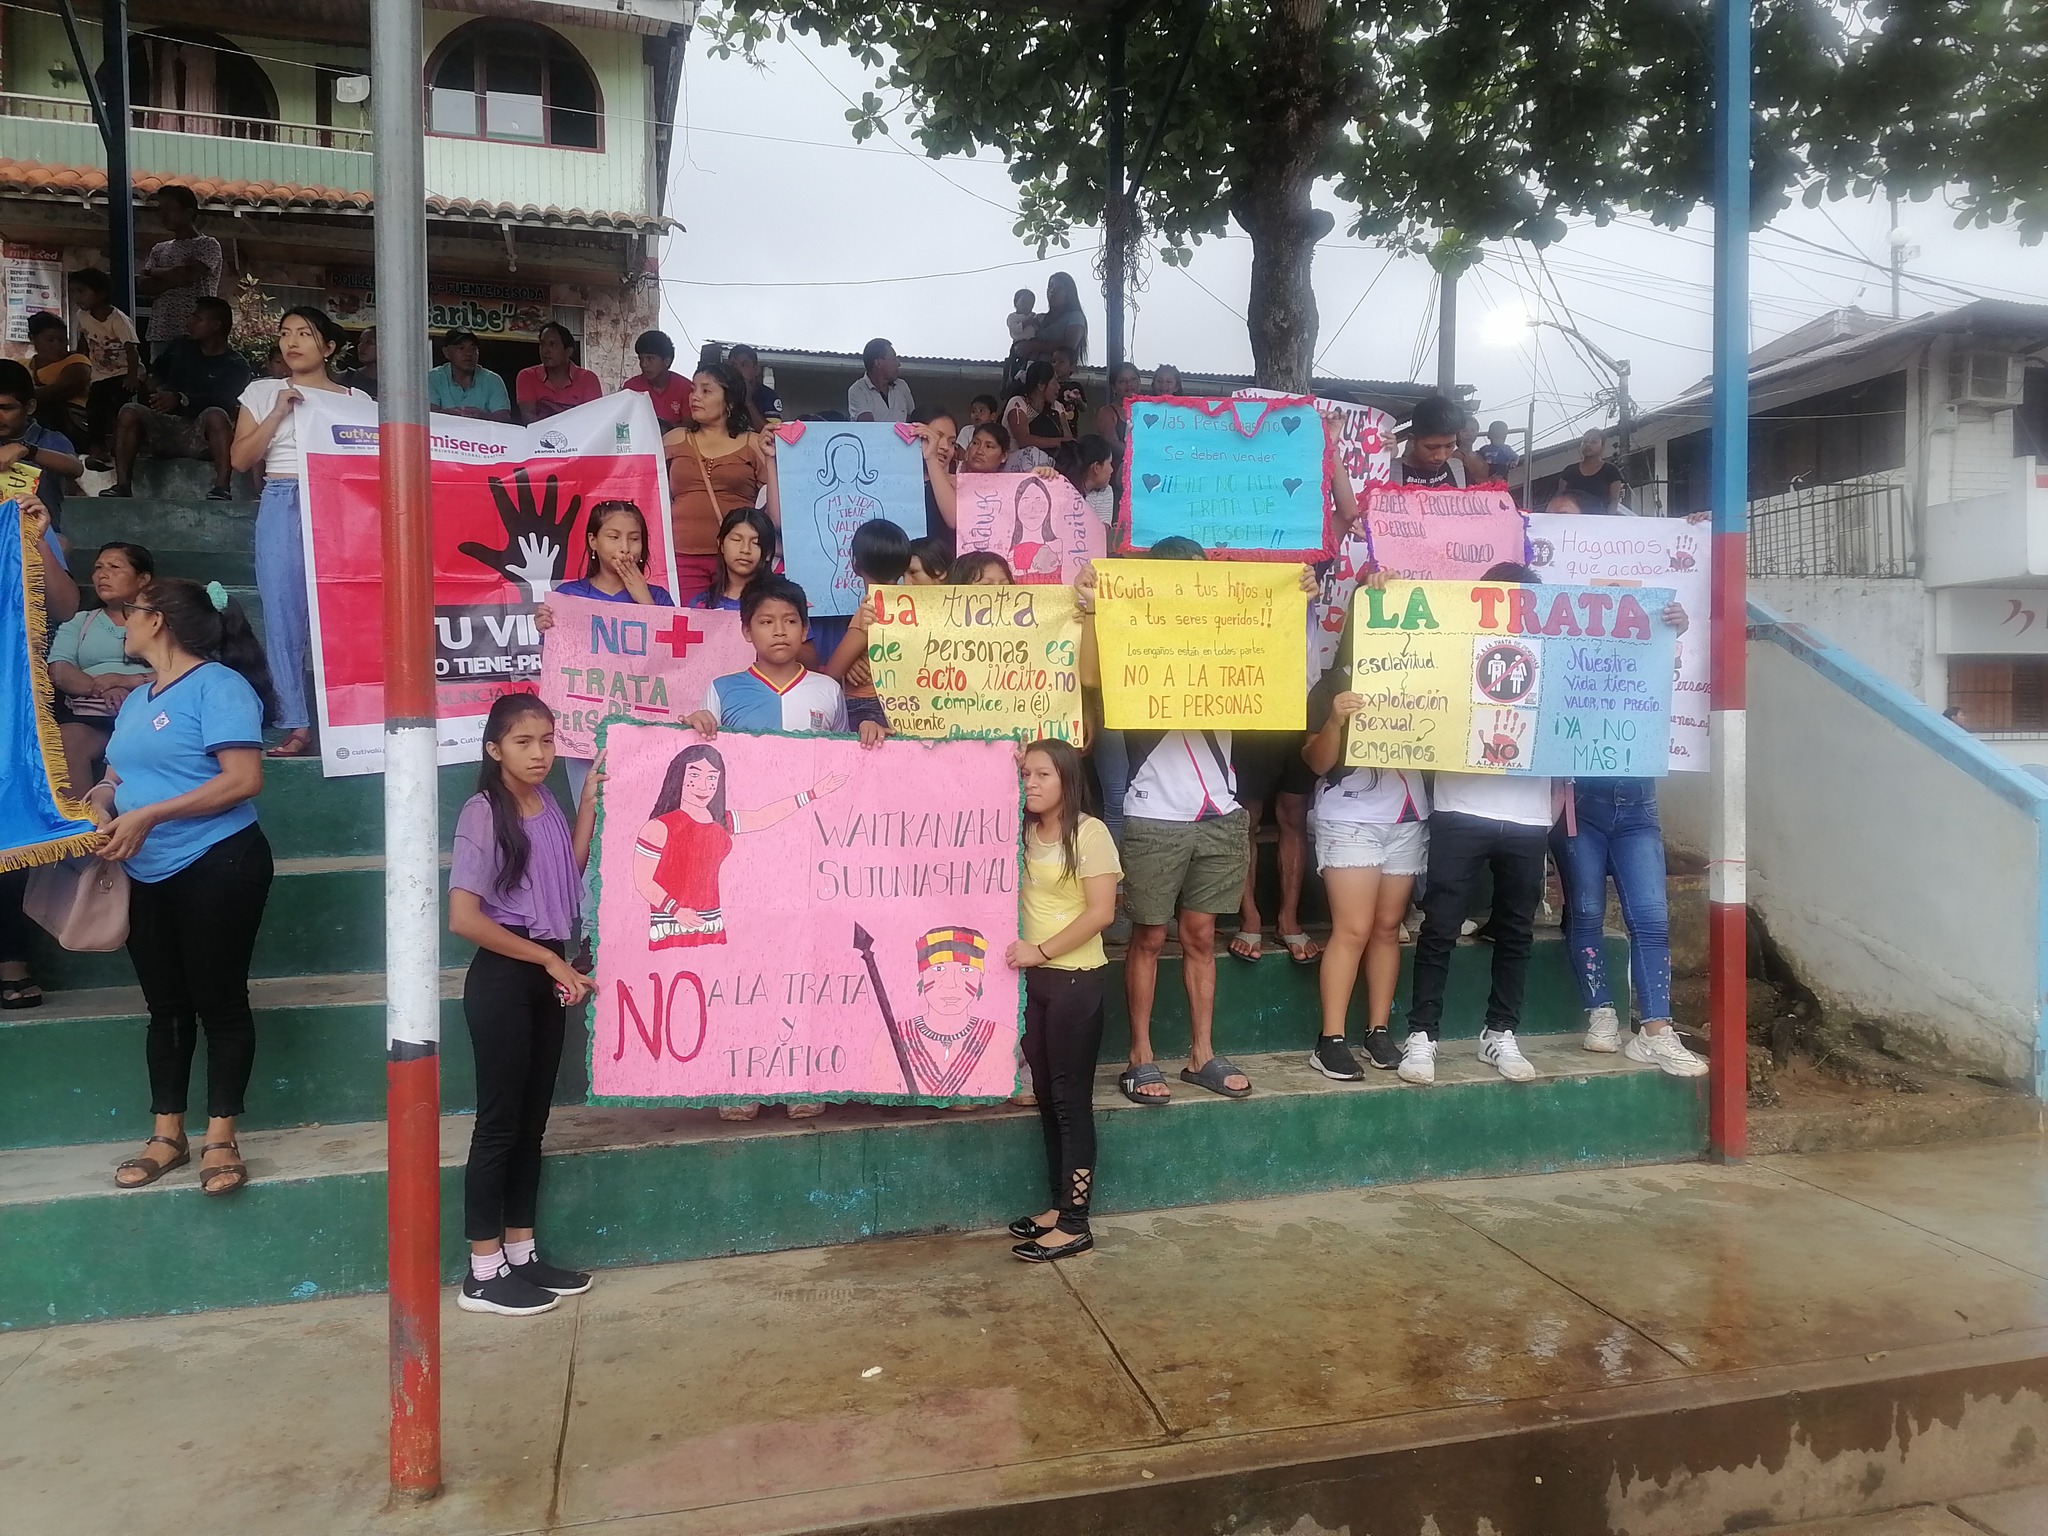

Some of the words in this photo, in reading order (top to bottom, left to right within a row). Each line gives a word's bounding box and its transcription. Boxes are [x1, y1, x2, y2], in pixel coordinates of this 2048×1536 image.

[331, 273, 376, 289] POLLER
[447, 282, 493, 298] FUENTE
[493, 284, 510, 298] DE
[510, 285, 545, 301] SODA
[338, 429, 379, 439] cutiva
[1260, 420, 1280, 433] no
[1164, 445, 1185, 461] Se
[1191, 447, 1228, 460] deben
[1233, 451, 1277, 463] vender
[1216, 474, 1238, 493] NO
[828, 495, 842, 511] MI
[847, 494, 875, 509] VIDA
[837, 507, 867, 518] TIENE
[1187, 497, 1242, 518] TRATA
[1253, 496, 1276, 516] DE
[1373, 492, 1409, 516] TENER
[1416, 490, 1492, 516] PROTECCIÓN
[1374, 519, 1427, 539] DERECHO
[1562, 530, 1662, 559] Hagamos
[1566, 560, 1600, 579] que
[1608, 562, 1664, 577] acabe
[834, 577, 865, 589] PREC
[1175, 584, 1184, 596] a
[1195, 571, 1218, 598] tus
[1228, 571, 1258, 604] hijos
[1265, 587, 1273, 607] y
[874, 589, 919, 627] La
[942, 586, 1039, 628] trata
[1365, 587, 1439, 630] LA
[1470, 587, 1652, 641] TRATA
[1129, 614, 1138, 627] a
[1145, 603, 1166, 625] tus
[1175, 613, 1208, 626] seres
[1214, 608, 1273, 635] queridos!!
[591, 614, 647, 656] NO
[868, 628, 903, 662] de
[923, 631, 1029, 667] personas
[1045, 639, 1075, 666] es
[1127, 643, 1142, 657] Los
[1143, 646, 1174, 659] engaños
[1177, 640, 1199, 657] están
[1239, 638, 1266, 659] partes
[1566, 645, 1637, 673] Nuestra
[435, 658, 450, 675] O
[453, 655, 514, 674] TIENE
[517, 654, 542, 671] PR
[1357, 651, 1439, 675] esclavitud.
[561, 667, 669, 707] TRATA
[874, 668, 897, 690] un
[916, 661, 967, 691] acto
[1055, 670, 1076, 693] no
[1123, 664, 1149, 688] NO
[1163, 664, 1175, 687] A
[1188, 663, 1209, 688] LA
[1219, 664, 1265, 687] TRATA
[1603, 673, 1647, 693] tiene
[608, 700, 631, 716] DE
[879, 694, 921, 712] seas
[931, 692, 1010, 715] cómplice,
[1013, 696, 1026, 714] la
[1149, 695, 1172, 719] DE
[1183, 693, 1263, 718] PERSONAS
[1564, 695, 1599, 711] VALOR,
[551, 709, 600, 733] PERS
[888, 713, 946, 732] guiente
[1603, 718, 1636, 741] NO
[1350, 740, 1438, 765] engaños.
[1481, 742, 1519, 760] NO
[613, 971, 708, 1063] NO
[708, 979, 726, 1007] A
[735, 974, 769, 1006] LA
[782, 972, 871, 1005] TRATA
[723, 1041, 848, 1078] TRÁFICO
